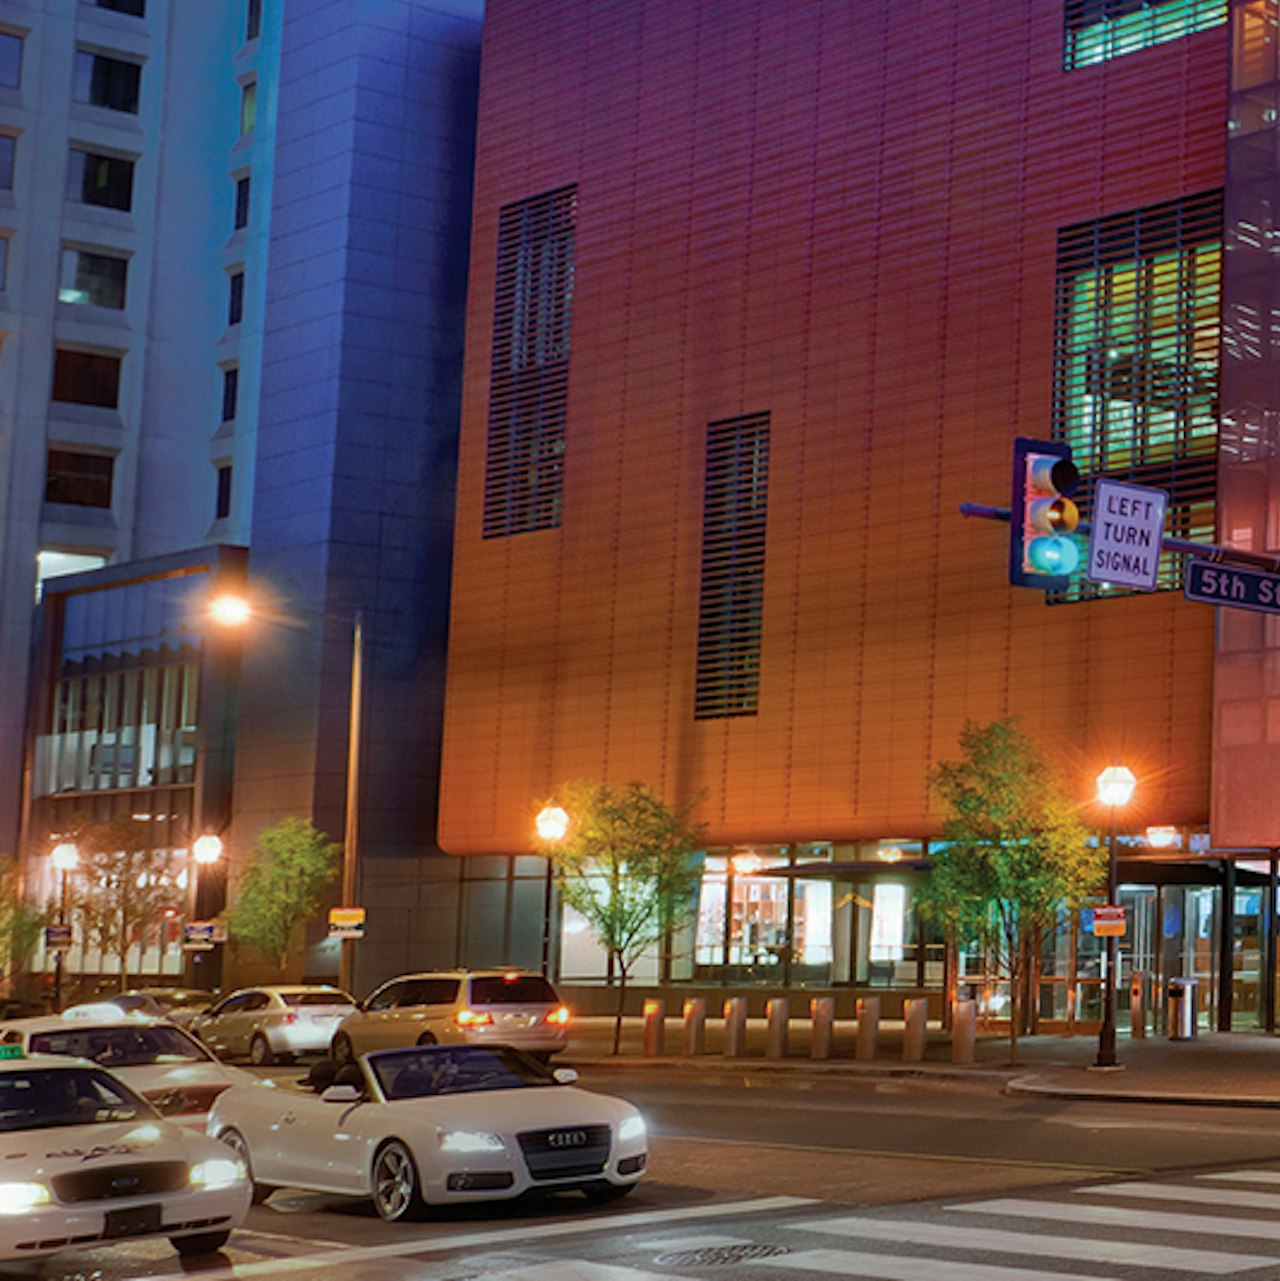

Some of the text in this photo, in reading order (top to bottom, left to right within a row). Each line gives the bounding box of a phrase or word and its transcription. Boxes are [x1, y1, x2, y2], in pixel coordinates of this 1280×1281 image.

[1107, 495, 1152, 520] LEFT
[1104, 522, 1151, 547] TURN
[1096, 549, 1150, 576] SIGNAL
[1200, 569, 1246, 600] 5th
